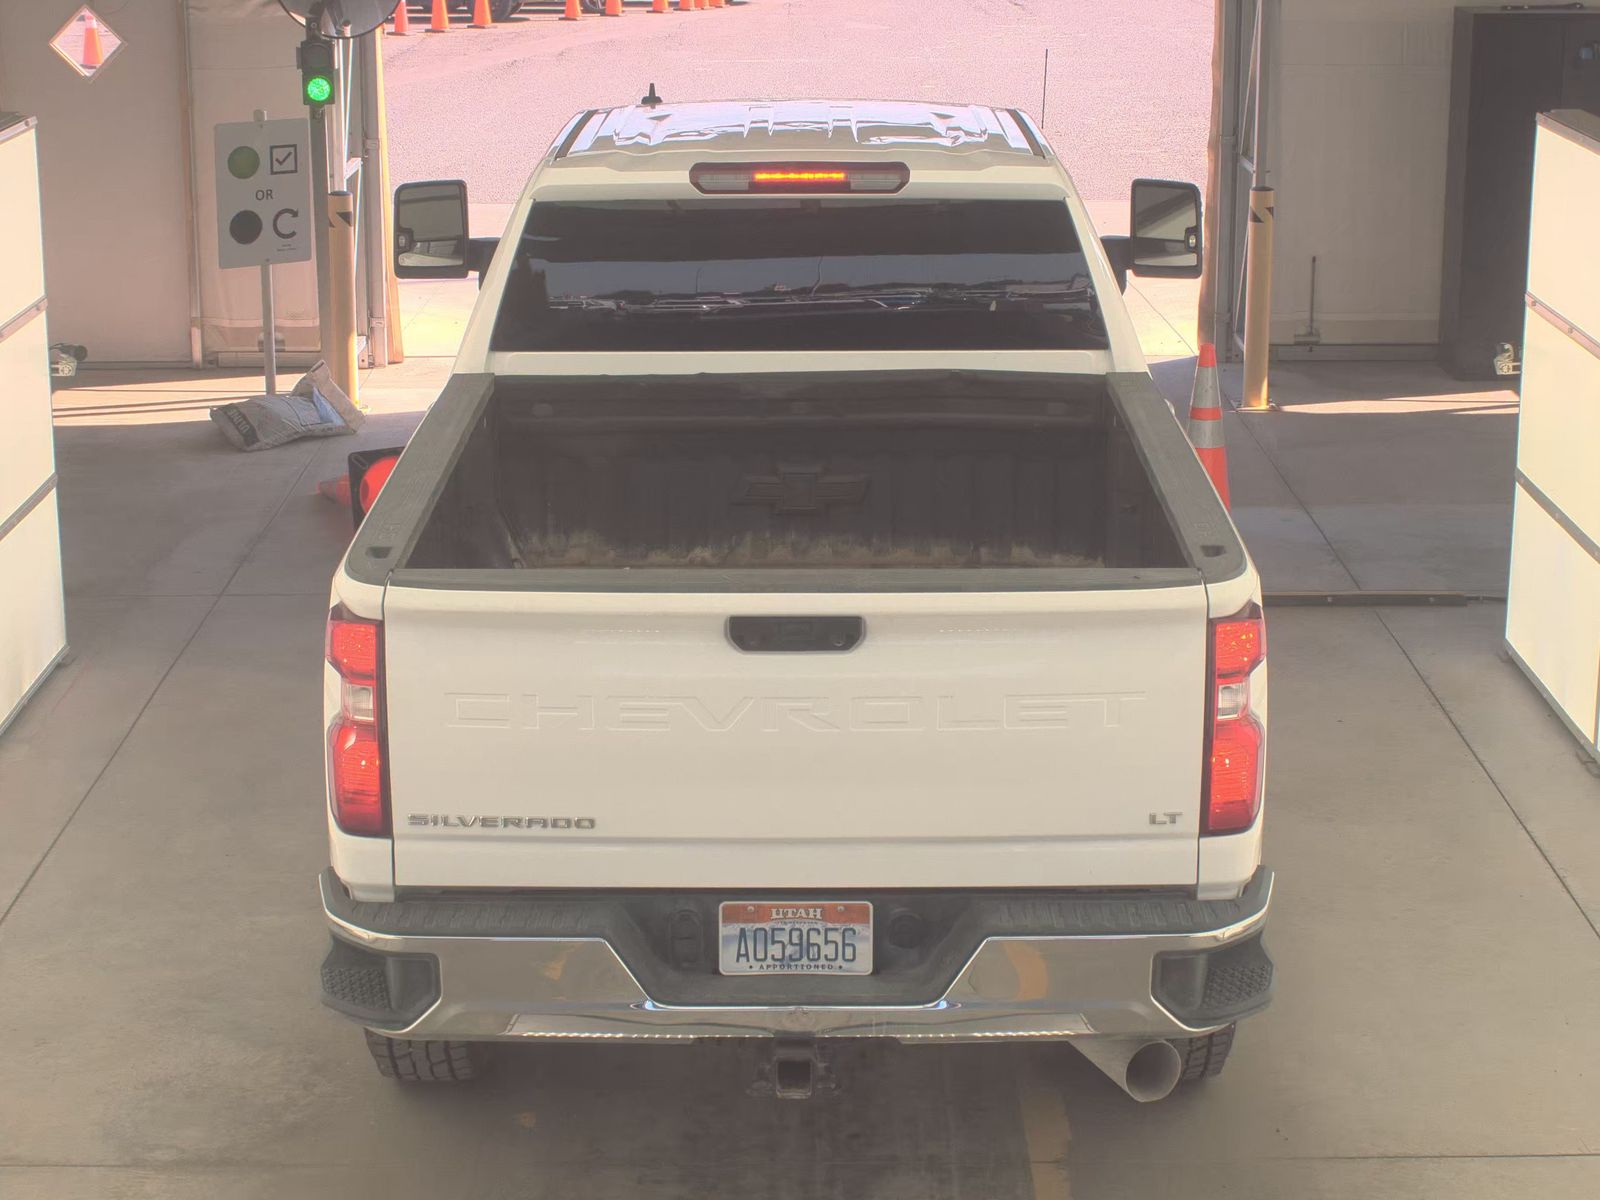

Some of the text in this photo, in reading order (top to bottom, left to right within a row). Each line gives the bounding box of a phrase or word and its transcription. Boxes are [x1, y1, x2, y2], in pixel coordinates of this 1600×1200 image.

[255, 189, 274, 201] OR
[443, 690, 1147, 733] CHEVROLET
[408, 813, 596, 829] SILVERADO
[1149, 811, 1184, 825] LT
[770, 907, 823, 920] UTAH
[736, 927, 857, 963] A059656
[759, 963, 834, 971] APPORTIONED
